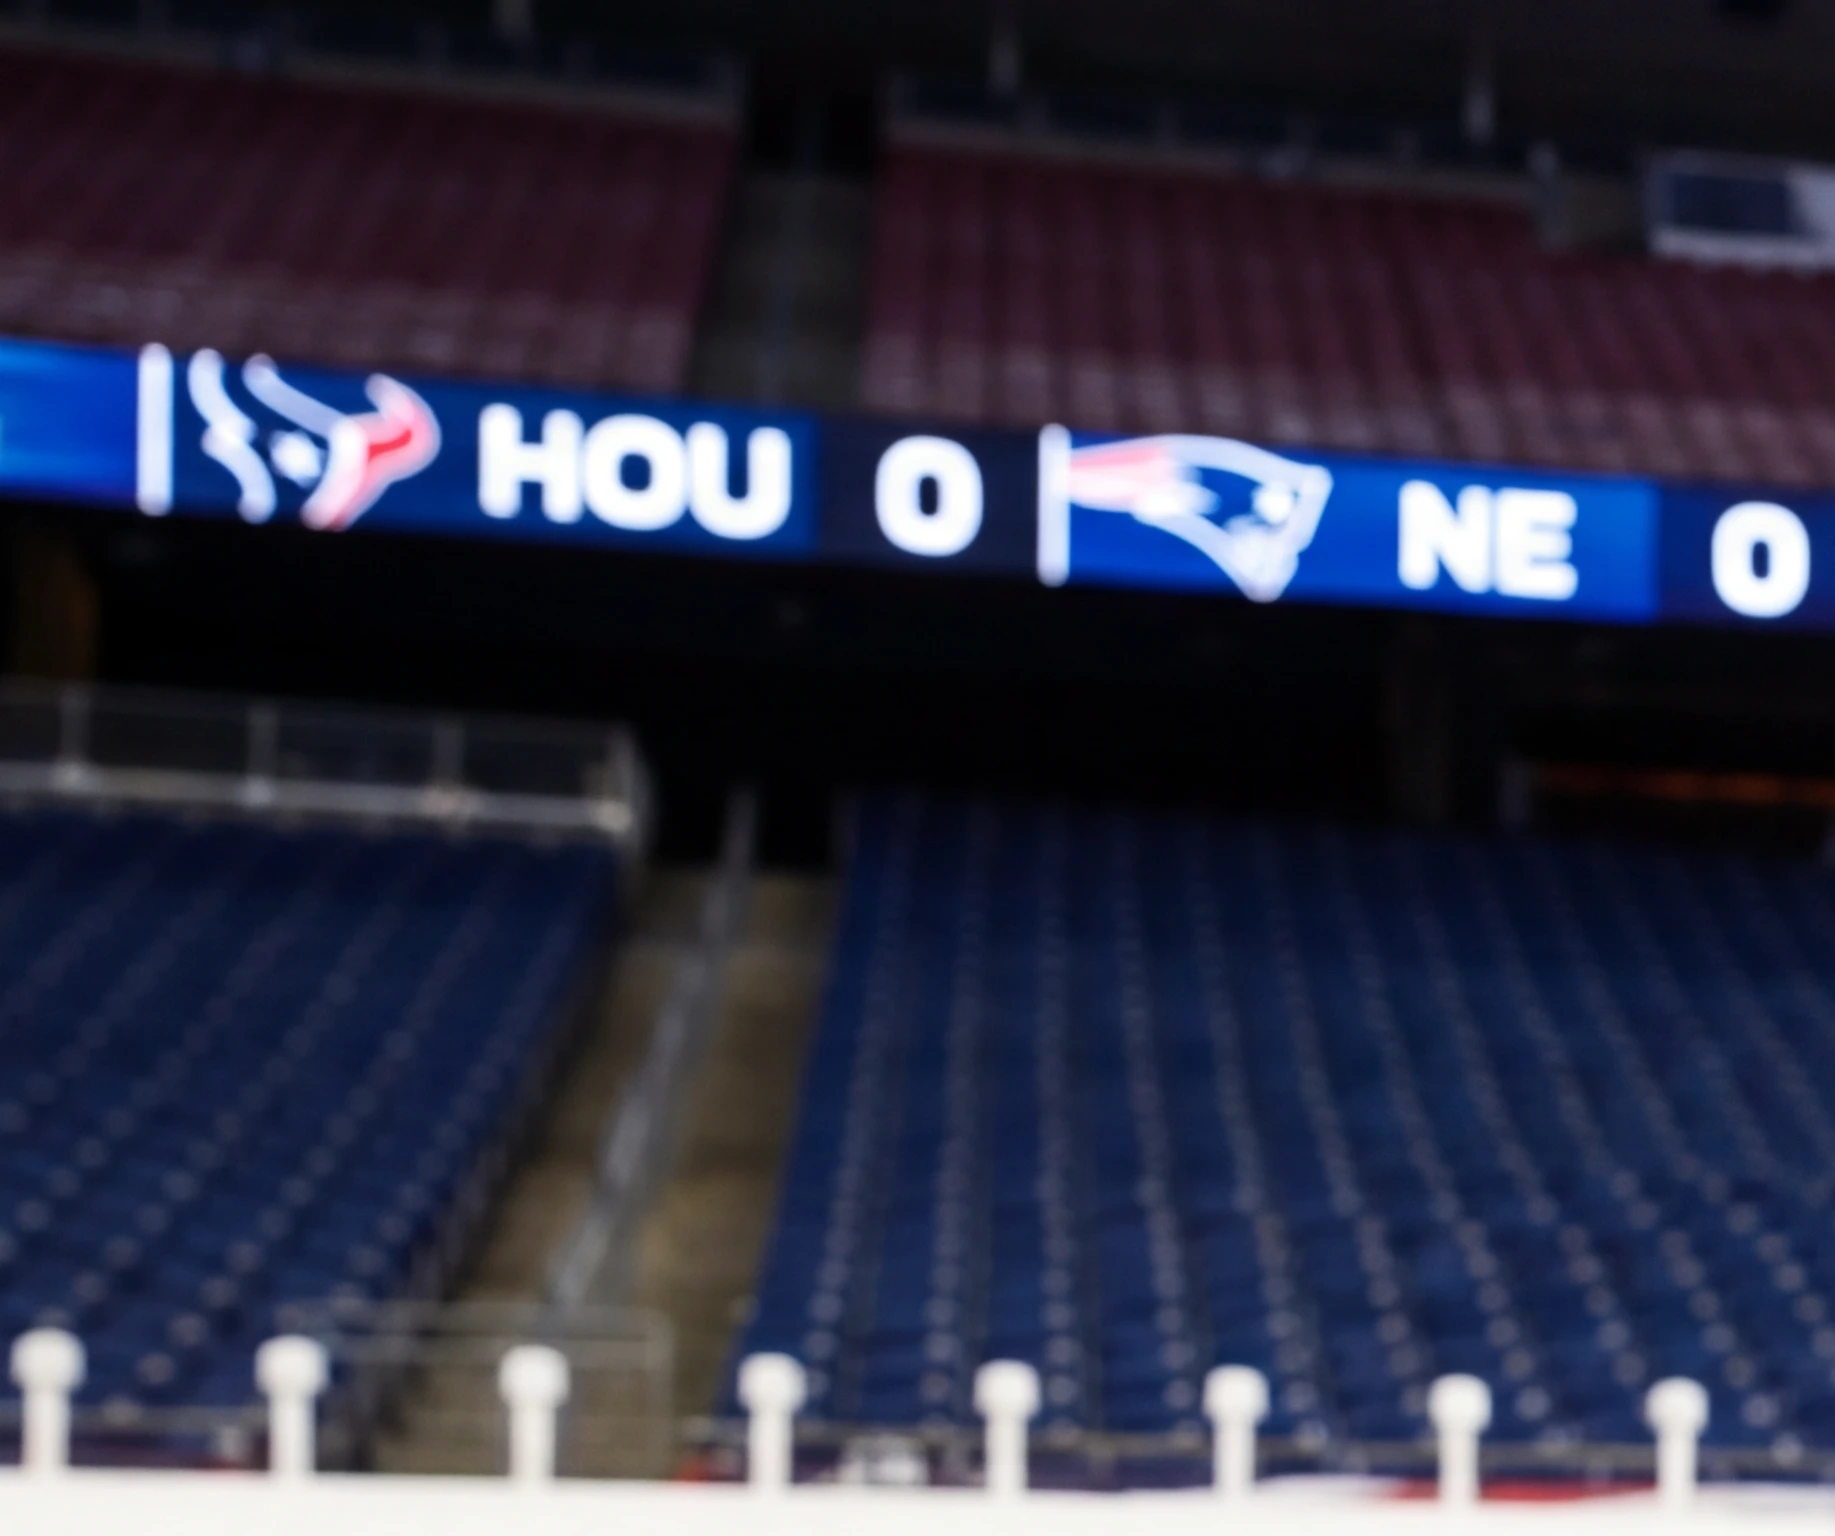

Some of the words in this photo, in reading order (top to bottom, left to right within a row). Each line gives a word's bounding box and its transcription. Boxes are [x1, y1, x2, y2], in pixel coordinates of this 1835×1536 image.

[479, 404, 792, 540] HOU
[876, 435, 984, 557] 0
[1399, 480, 1578, 600] NE
[1712, 502, 1811, 618] 0
